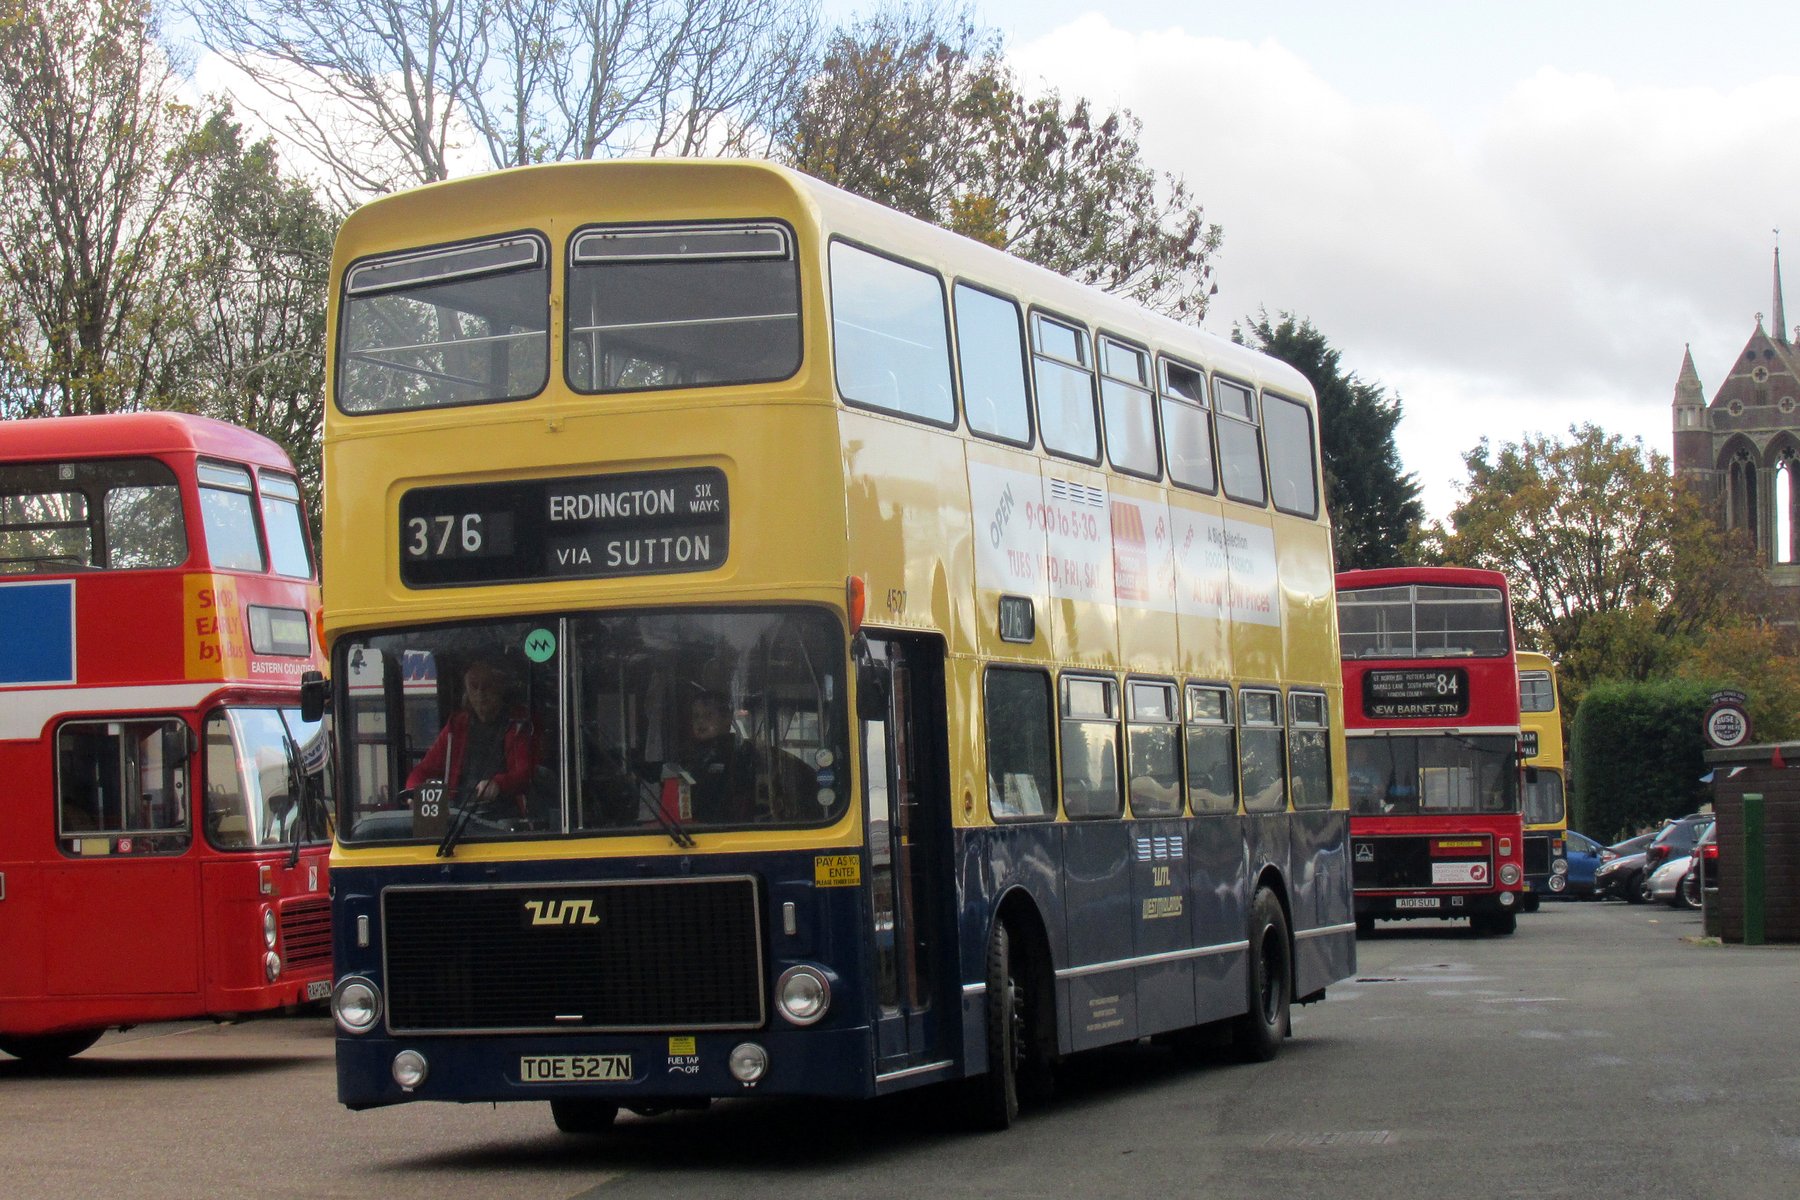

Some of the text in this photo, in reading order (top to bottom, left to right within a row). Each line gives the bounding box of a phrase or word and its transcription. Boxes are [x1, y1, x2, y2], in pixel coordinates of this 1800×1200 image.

[695, 484, 711, 498] SIX
[550, 489, 675, 521] ERDINGTON
[689, 499, 720, 513] WAYS
[990, 482, 1014, 549] OPEN
[408, 513, 482, 556] 376
[557, 535, 710, 567] VIA SUTTON
[887, 588, 907, 614] 4527
[196, 617, 239, 636] EARLY
[199, 641, 222, 662] by
[251, 662, 284, 674] EASTERN
[1437, 674, 1458, 695] 84
[1397, 704, 1436, 714] BARNET
[1438, 704, 1458, 713] STN
[420, 789, 443, 803] 107
[421, 804, 439, 817] 03
[816, 857, 834, 868] PAY
[837, 856, 848, 866] AS
[829, 867, 855, 877] ENTER
[523, 1058, 630, 1079] TOE 527N
[668, 1056, 699, 1065] FUEL TAP
